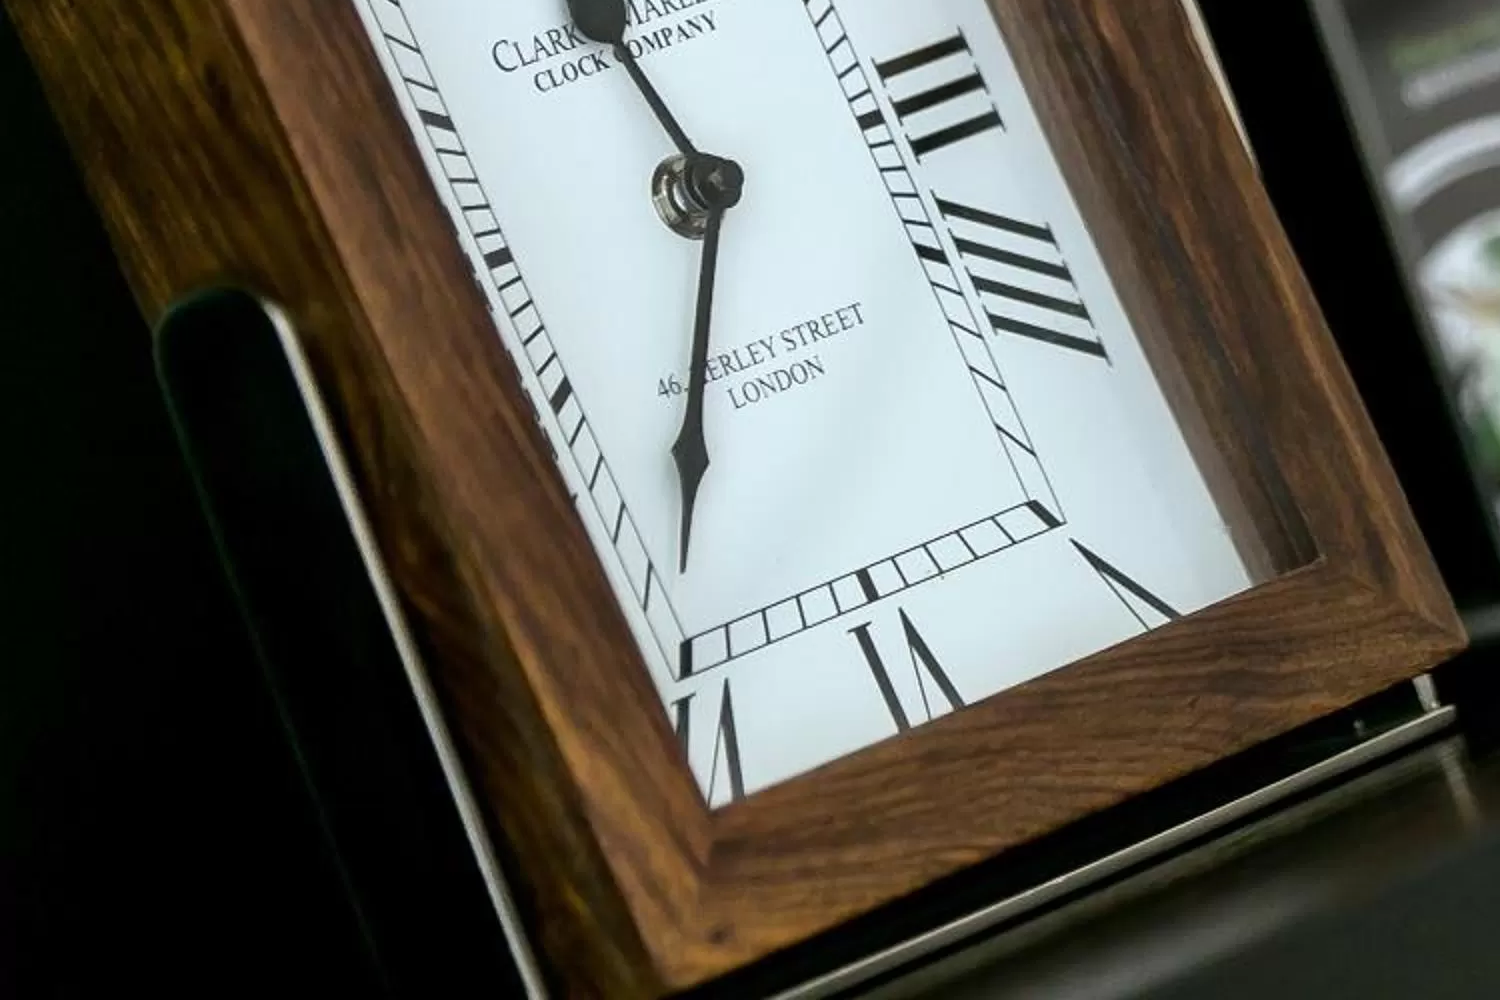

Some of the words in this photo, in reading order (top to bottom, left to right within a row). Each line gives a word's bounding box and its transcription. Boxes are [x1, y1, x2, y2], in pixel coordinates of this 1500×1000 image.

[533, 49, 612, 93] CLOCK
[870, 25, 1007, 166] III
[703, 335, 777, 386] ERLEY
[780, 301, 865, 352] STREET
[727, 353, 826, 410] LONDON
